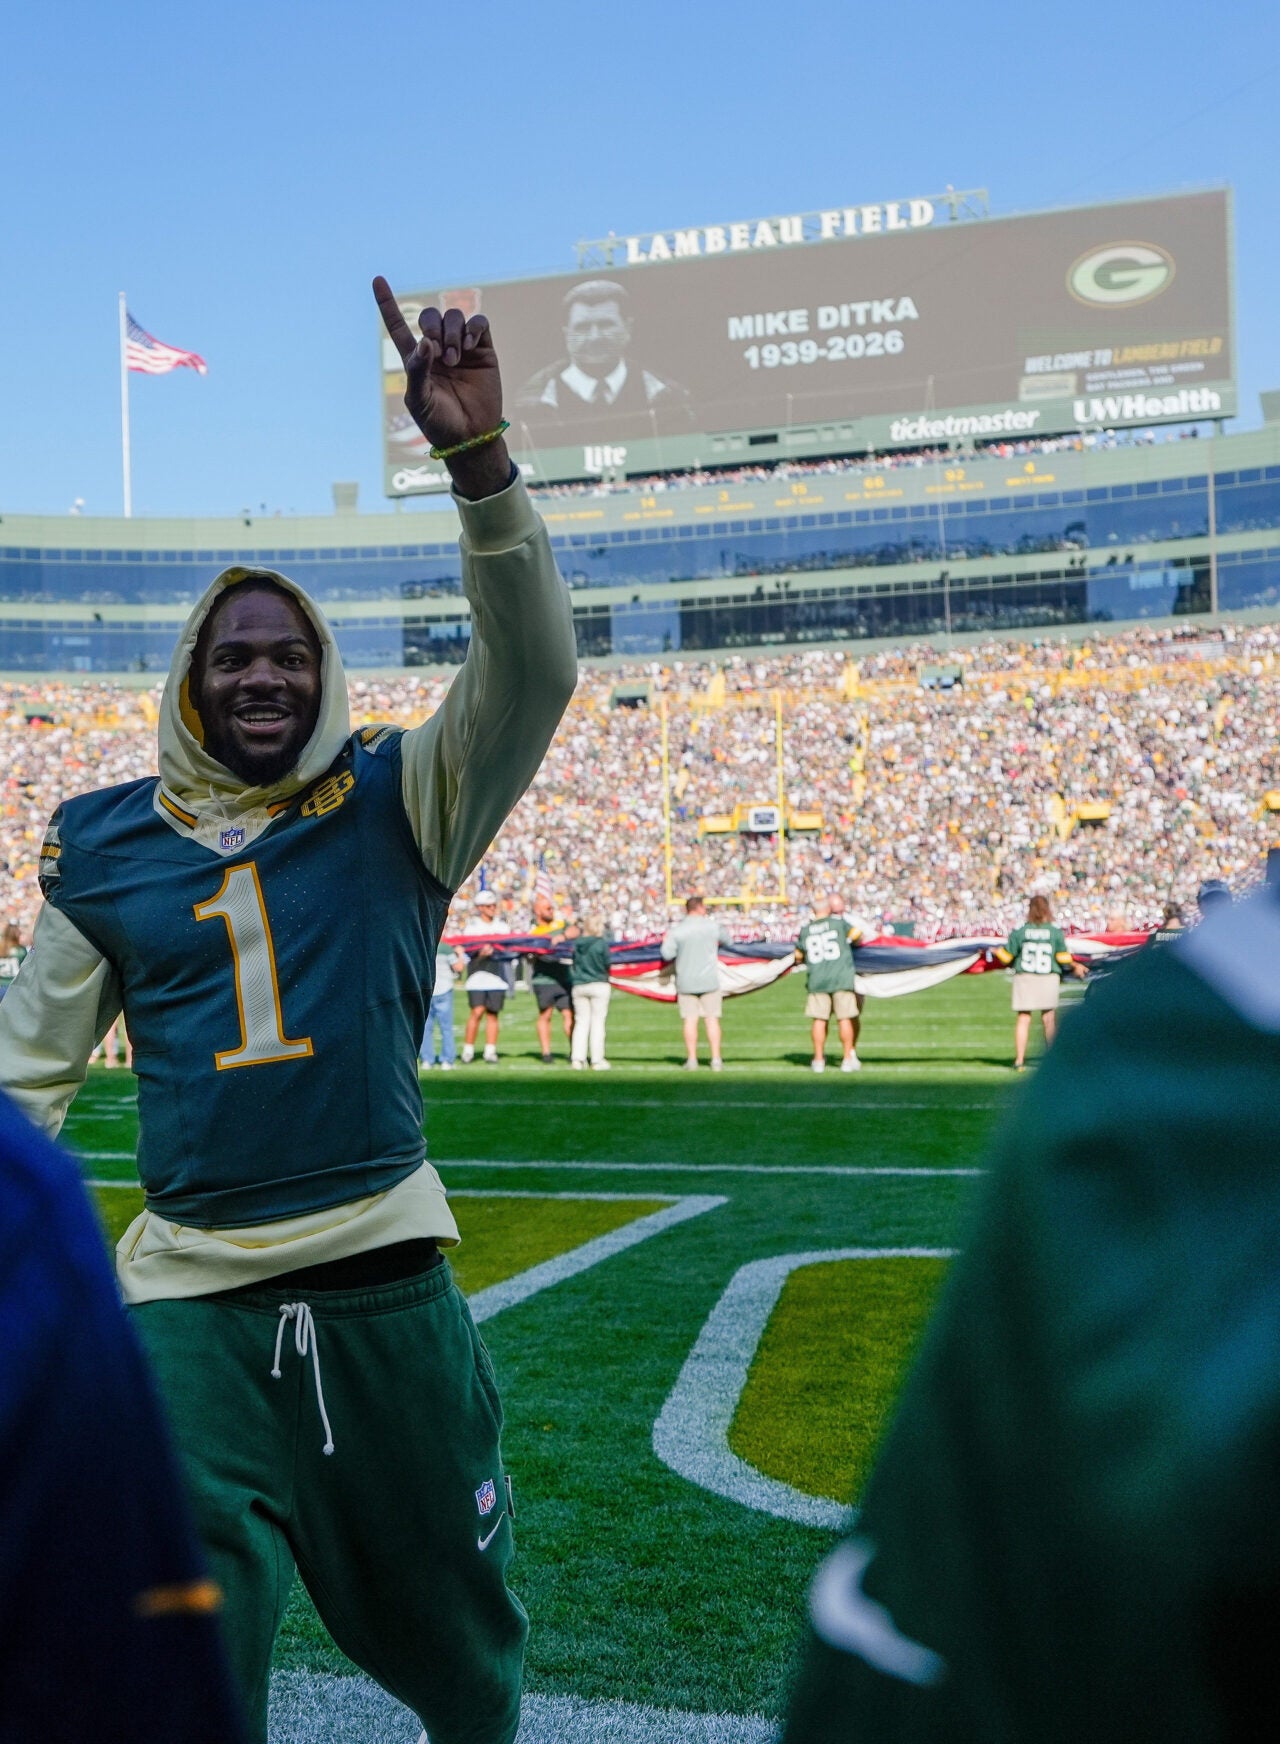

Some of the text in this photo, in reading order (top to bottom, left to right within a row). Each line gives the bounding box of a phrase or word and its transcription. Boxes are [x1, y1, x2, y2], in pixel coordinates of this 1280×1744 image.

[626, 200, 935, 263] LAMBEAU FIELD
[728, 296, 919, 340] MIKE DITKA
[743, 330, 905, 369] 1939-2026
[889, 409, 1041, 441] ticketmaster
[584, 445, 627, 474] Lite
[805, 929, 841, 964] 85
[1021, 941, 1053, 974] 56
[193, 861, 314, 1071] 1
